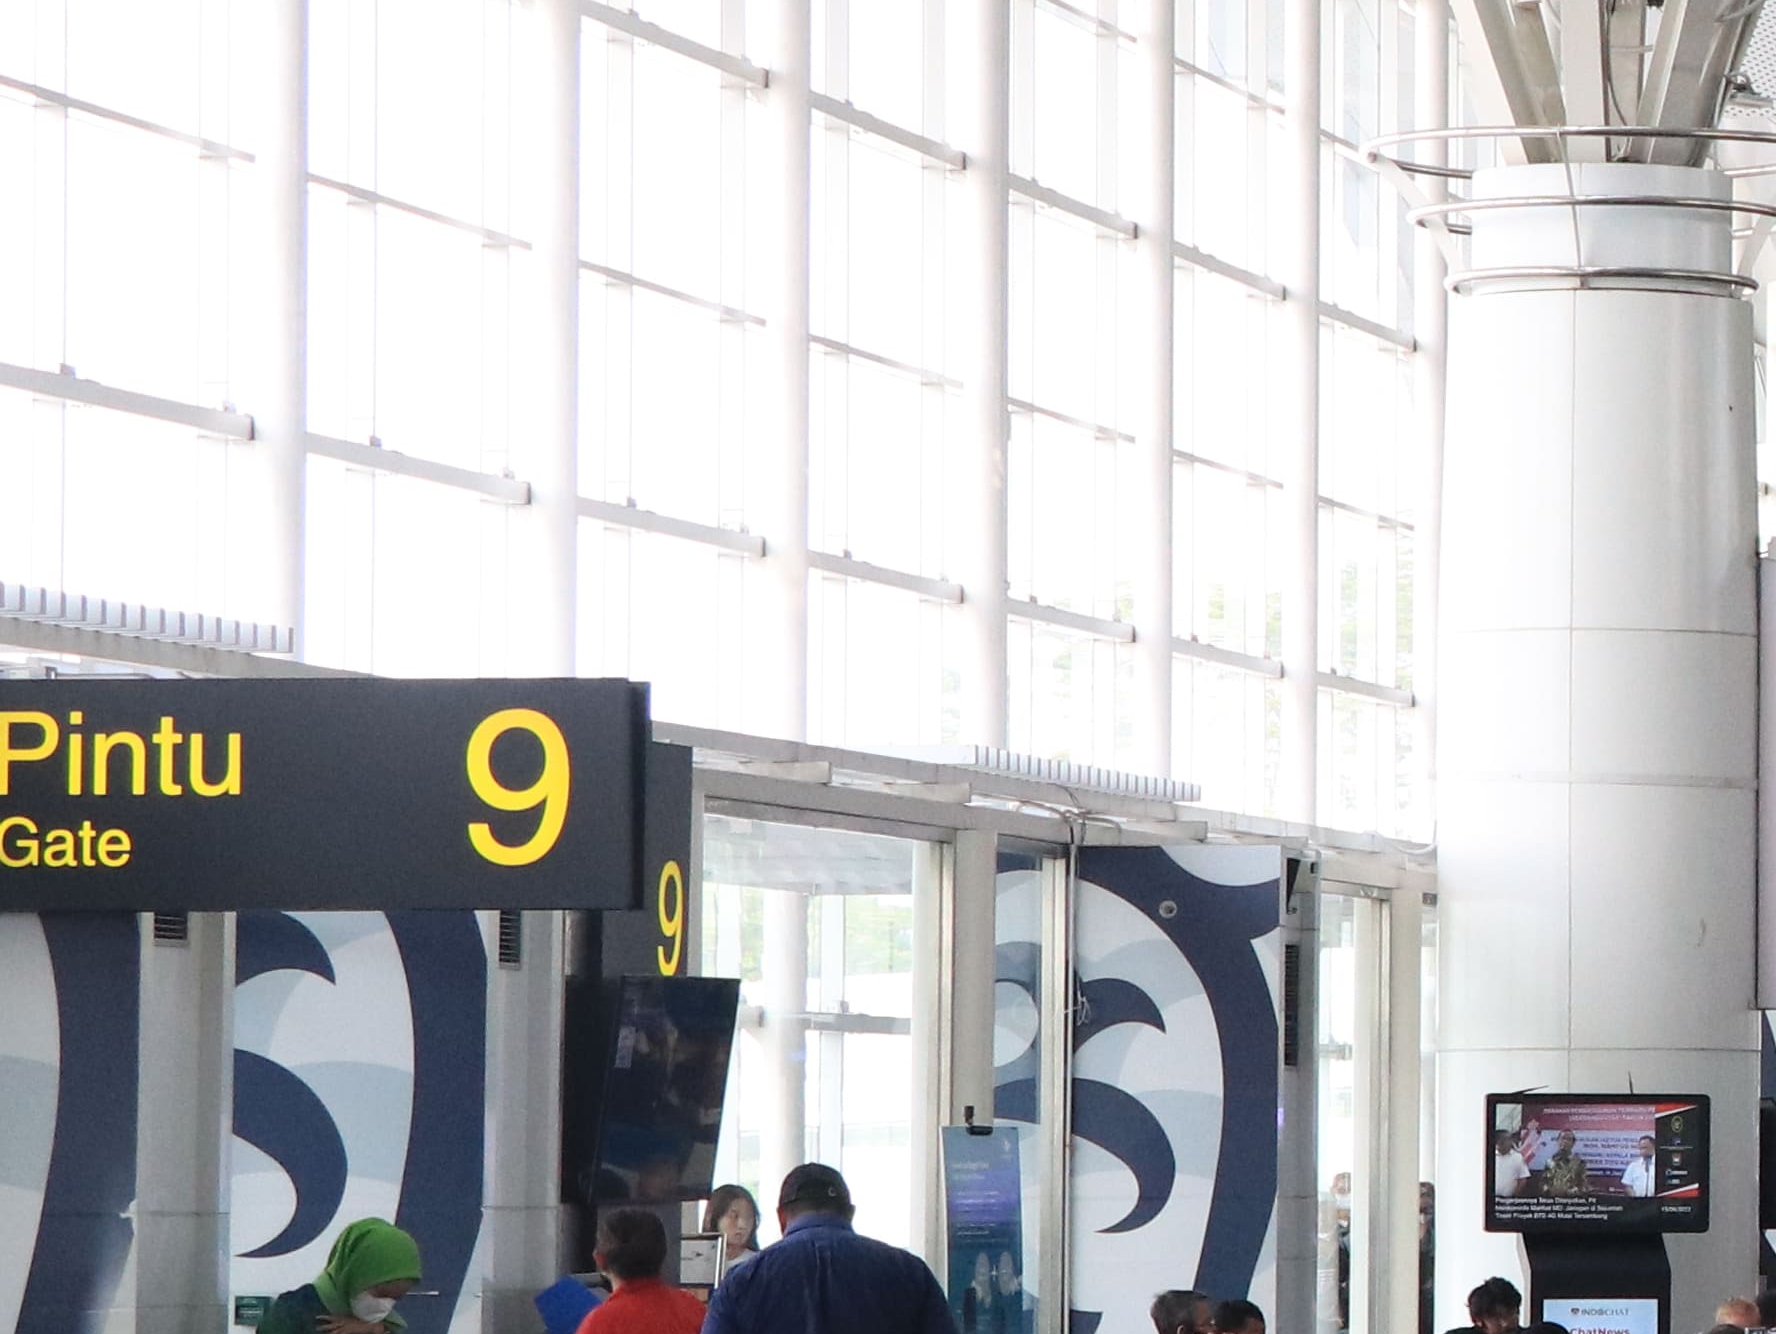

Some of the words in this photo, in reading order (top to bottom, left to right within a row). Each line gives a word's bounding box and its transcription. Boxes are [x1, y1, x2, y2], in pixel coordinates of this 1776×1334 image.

[0, 710, 243, 797] Pintu
[466, 708, 572, 866] 9
[0, 816, 133, 868] Gate
[657, 860, 684, 977] 9
